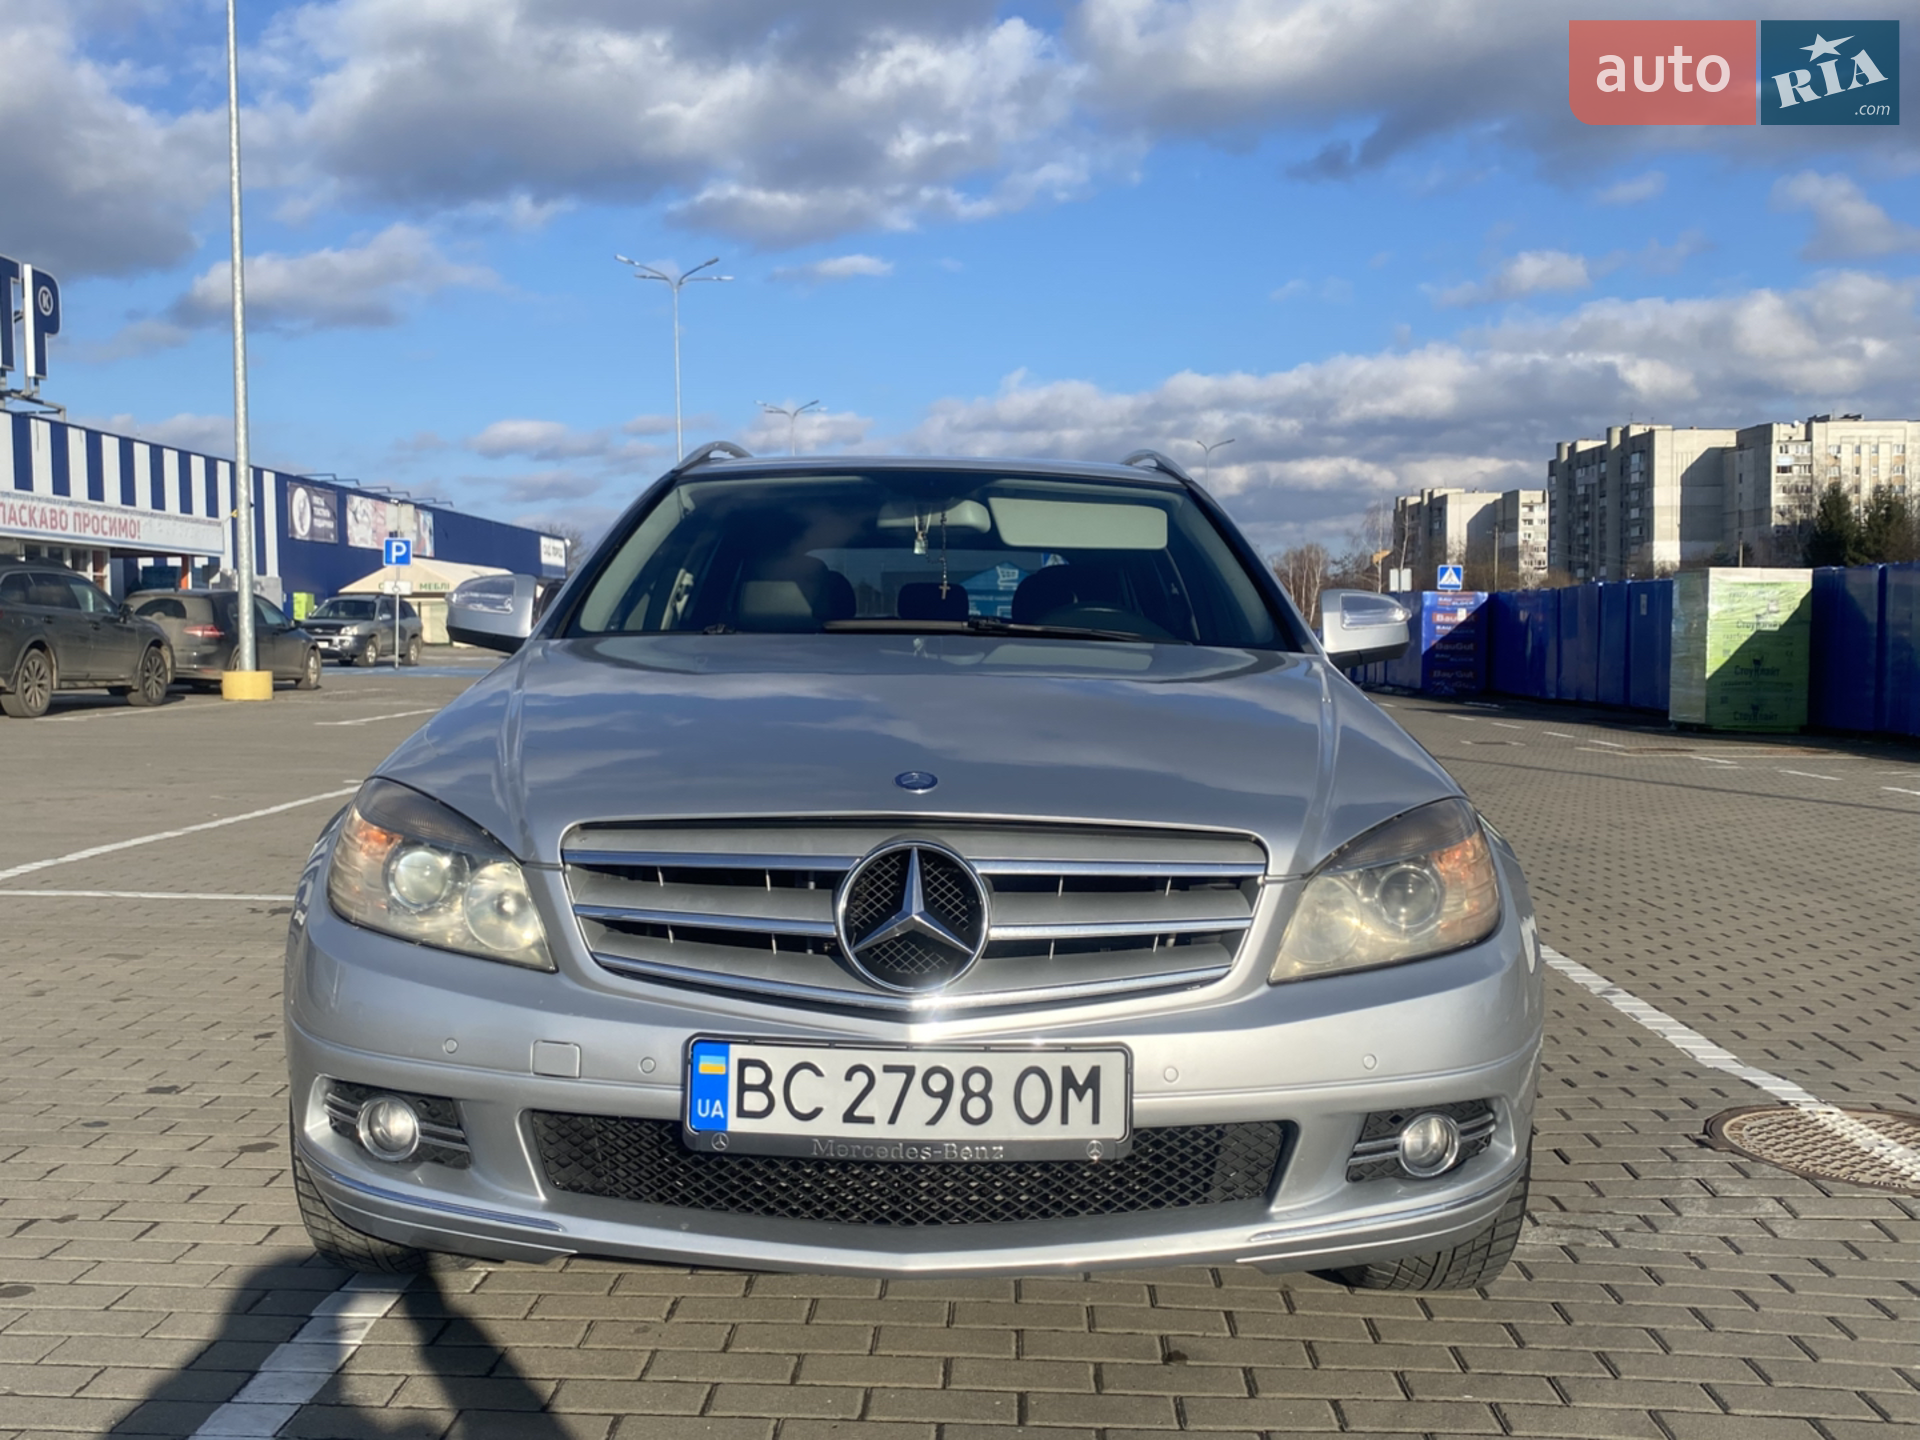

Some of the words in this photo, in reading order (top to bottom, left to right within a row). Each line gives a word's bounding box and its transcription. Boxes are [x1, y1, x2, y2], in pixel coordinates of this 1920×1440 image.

[73, 511, 141, 540] ПРОСИМО!
[391, 541, 407, 564] P
[735, 1058, 824, 1121] BC
[842, 1063, 994, 1126] 2798
[1013, 1065, 1101, 1126] OM
[697, 1099, 724, 1118] UA
[811, 1138, 1004, 1161] Mercedes-Benz
